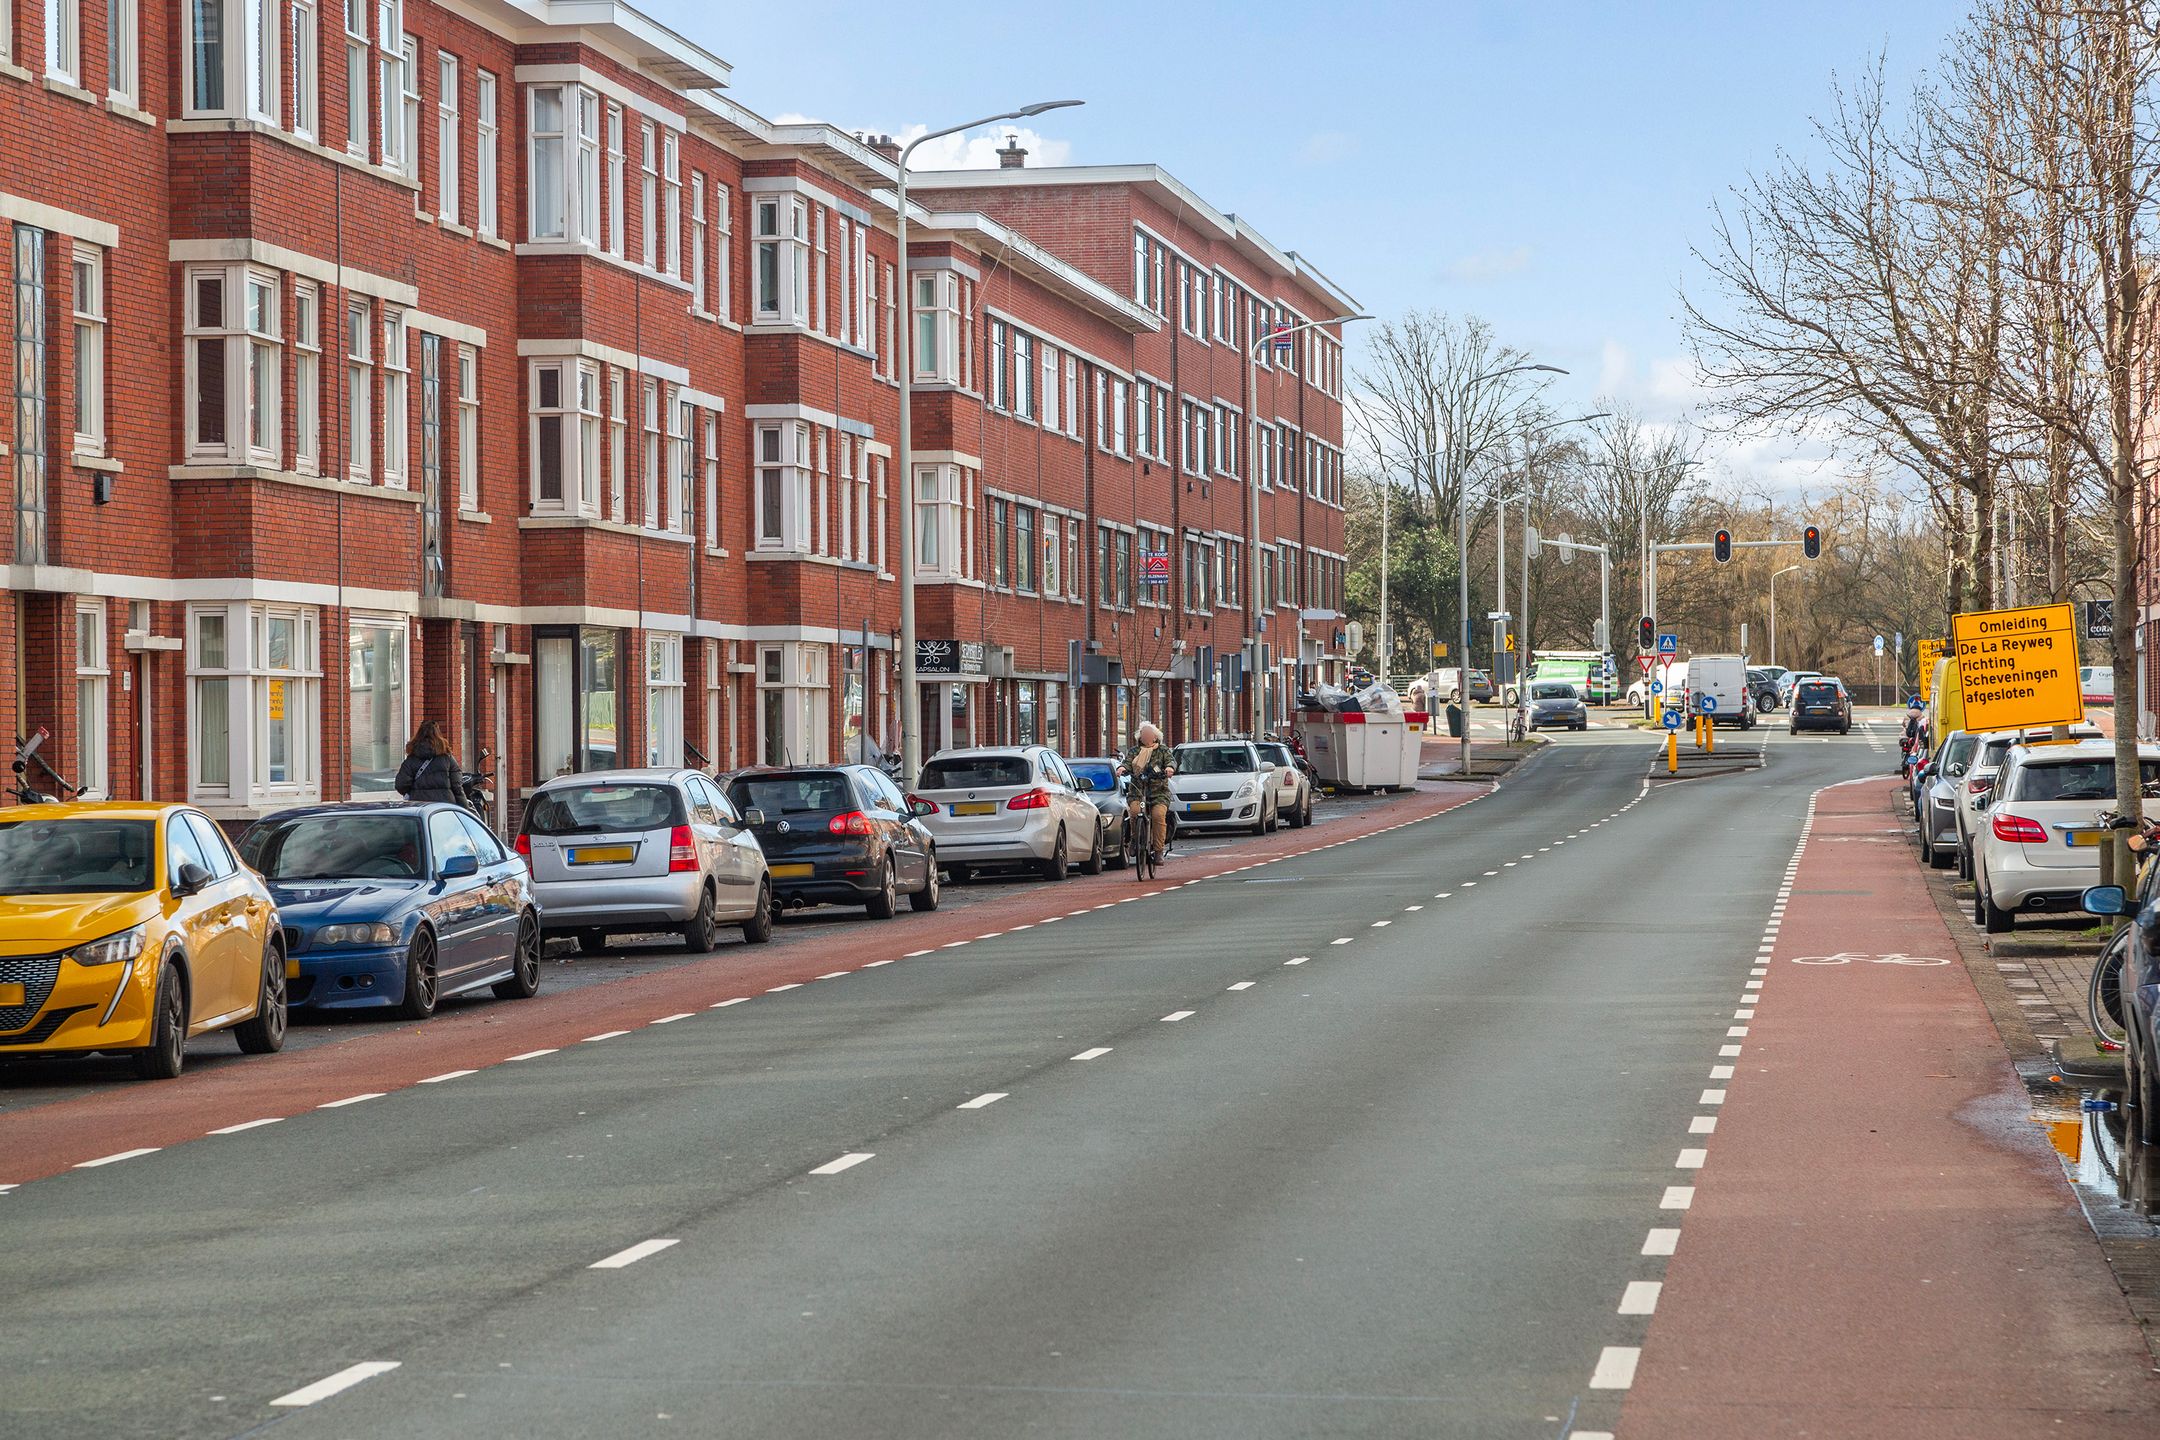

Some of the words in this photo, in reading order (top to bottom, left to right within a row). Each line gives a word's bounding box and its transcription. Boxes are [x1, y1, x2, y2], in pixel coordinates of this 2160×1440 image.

[1980, 617, 2047, 633] Omleiding
[1961, 643, 1977, 655] De
[1981, 642, 1997, 653] La
[2002, 637, 2053, 652] Reyweg
[1962, 657, 2015, 671] richting
[1964, 669, 2058, 687] Scheveningen
[1966, 687, 2034, 705] afgesloten
